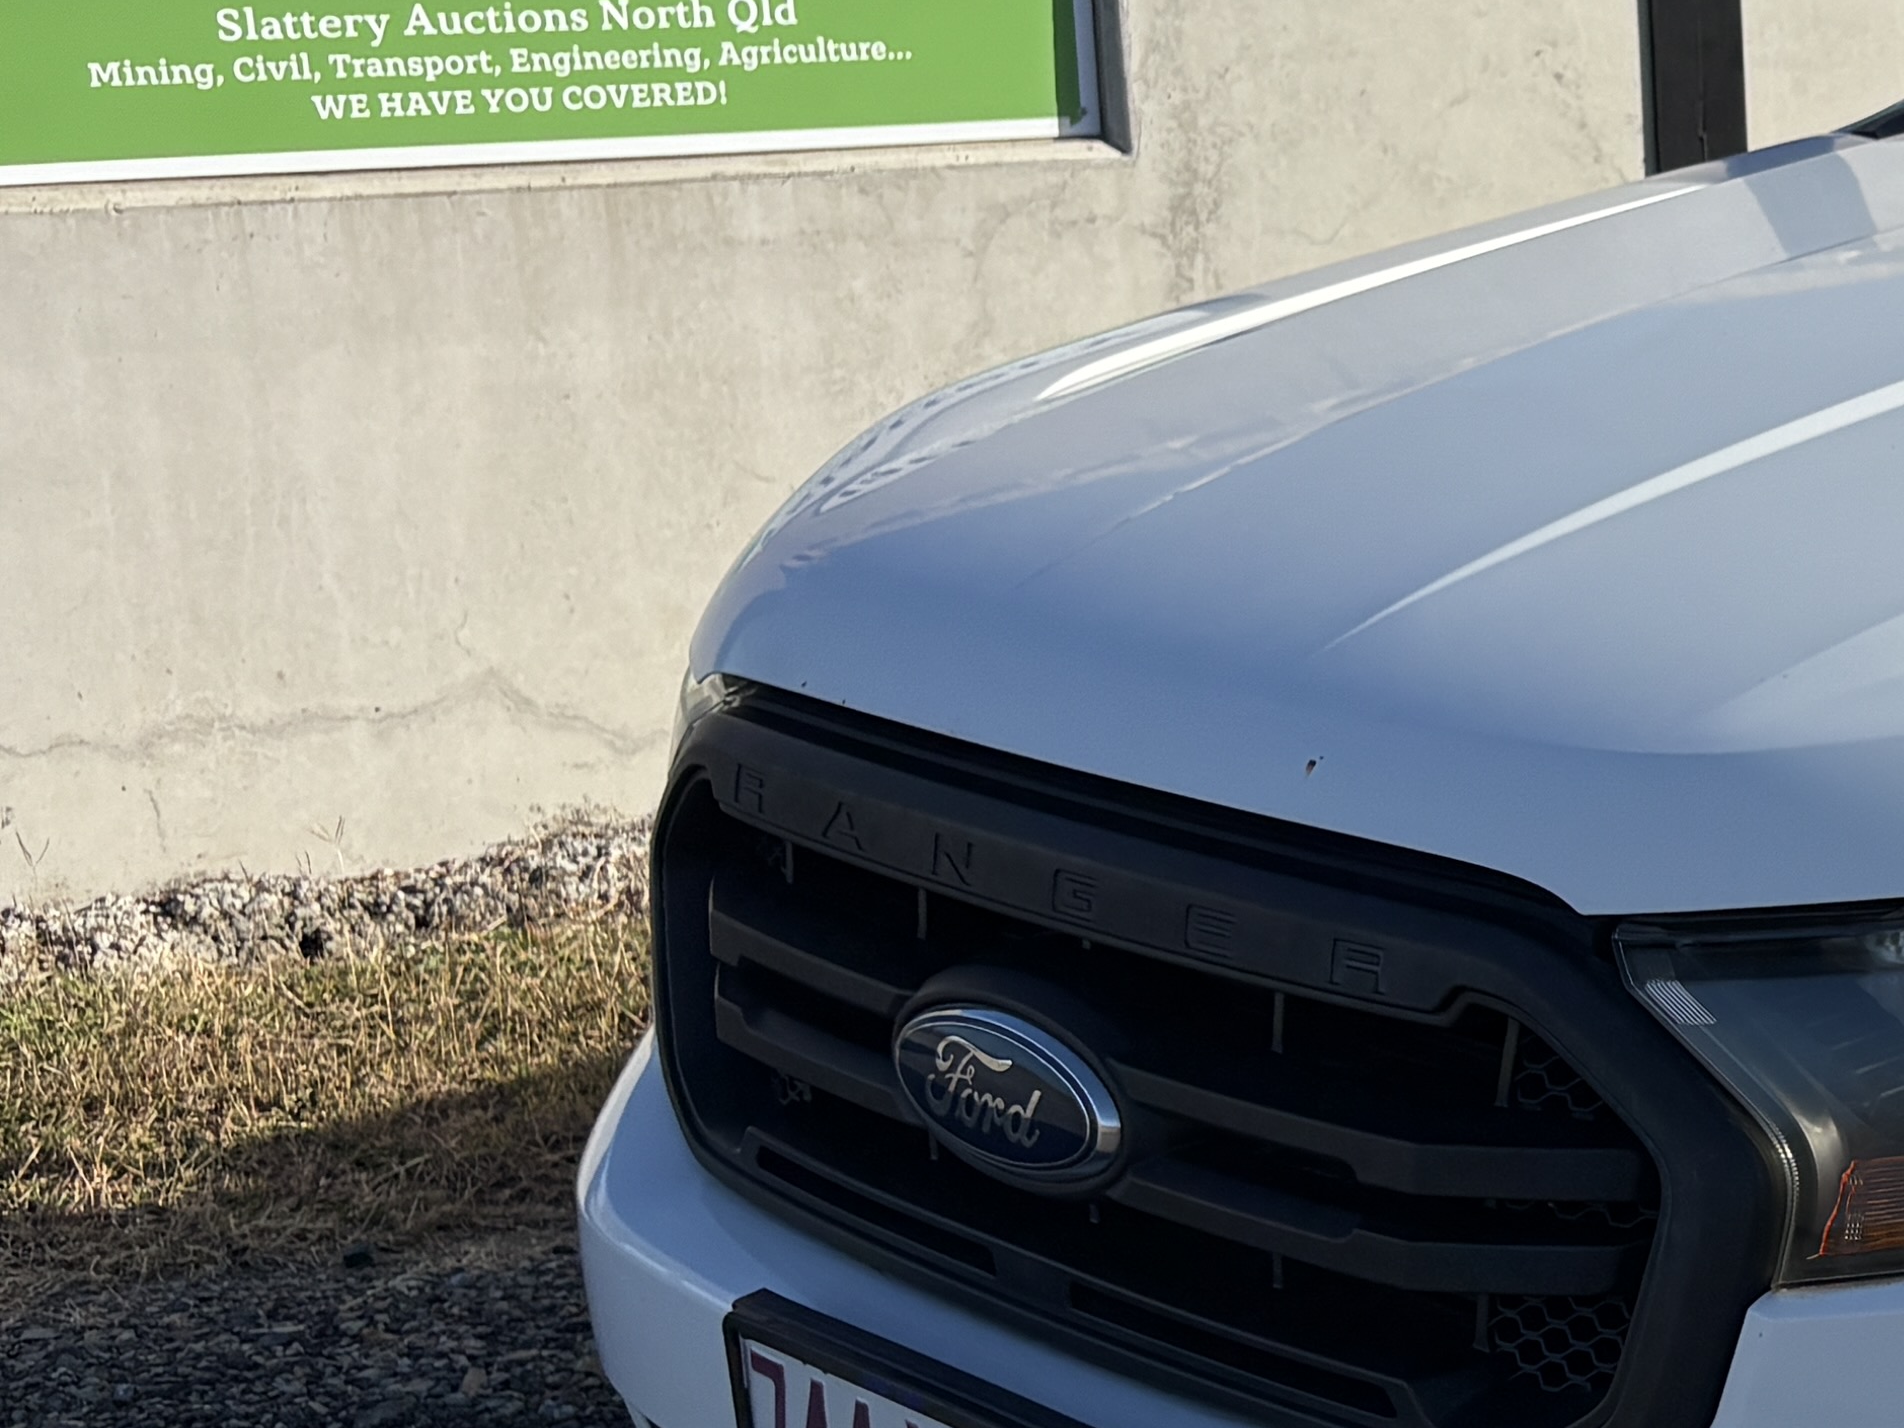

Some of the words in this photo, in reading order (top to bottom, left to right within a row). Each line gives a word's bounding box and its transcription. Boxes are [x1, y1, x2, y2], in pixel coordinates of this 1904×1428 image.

[215, 6, 392, 50] Slattery
[403, 1, 591, 39] Auctions
[87, 57, 227, 93] Mining,
[232, 51, 324, 86] Civil,
[327, 48, 504, 84] Transport,
[509, 41, 713, 80] Engineering,
[718, 34, 914, 74] Agriculture...
[310, 93, 373, 122] WE
[377, 89, 478, 120] HAVE
[480, 86, 555, 116] YOU
[562, 80, 729, 113] COVERED!
[733, 762, 1388, 996] RANGER
[927, 1033, 1043, 1149] Ford
